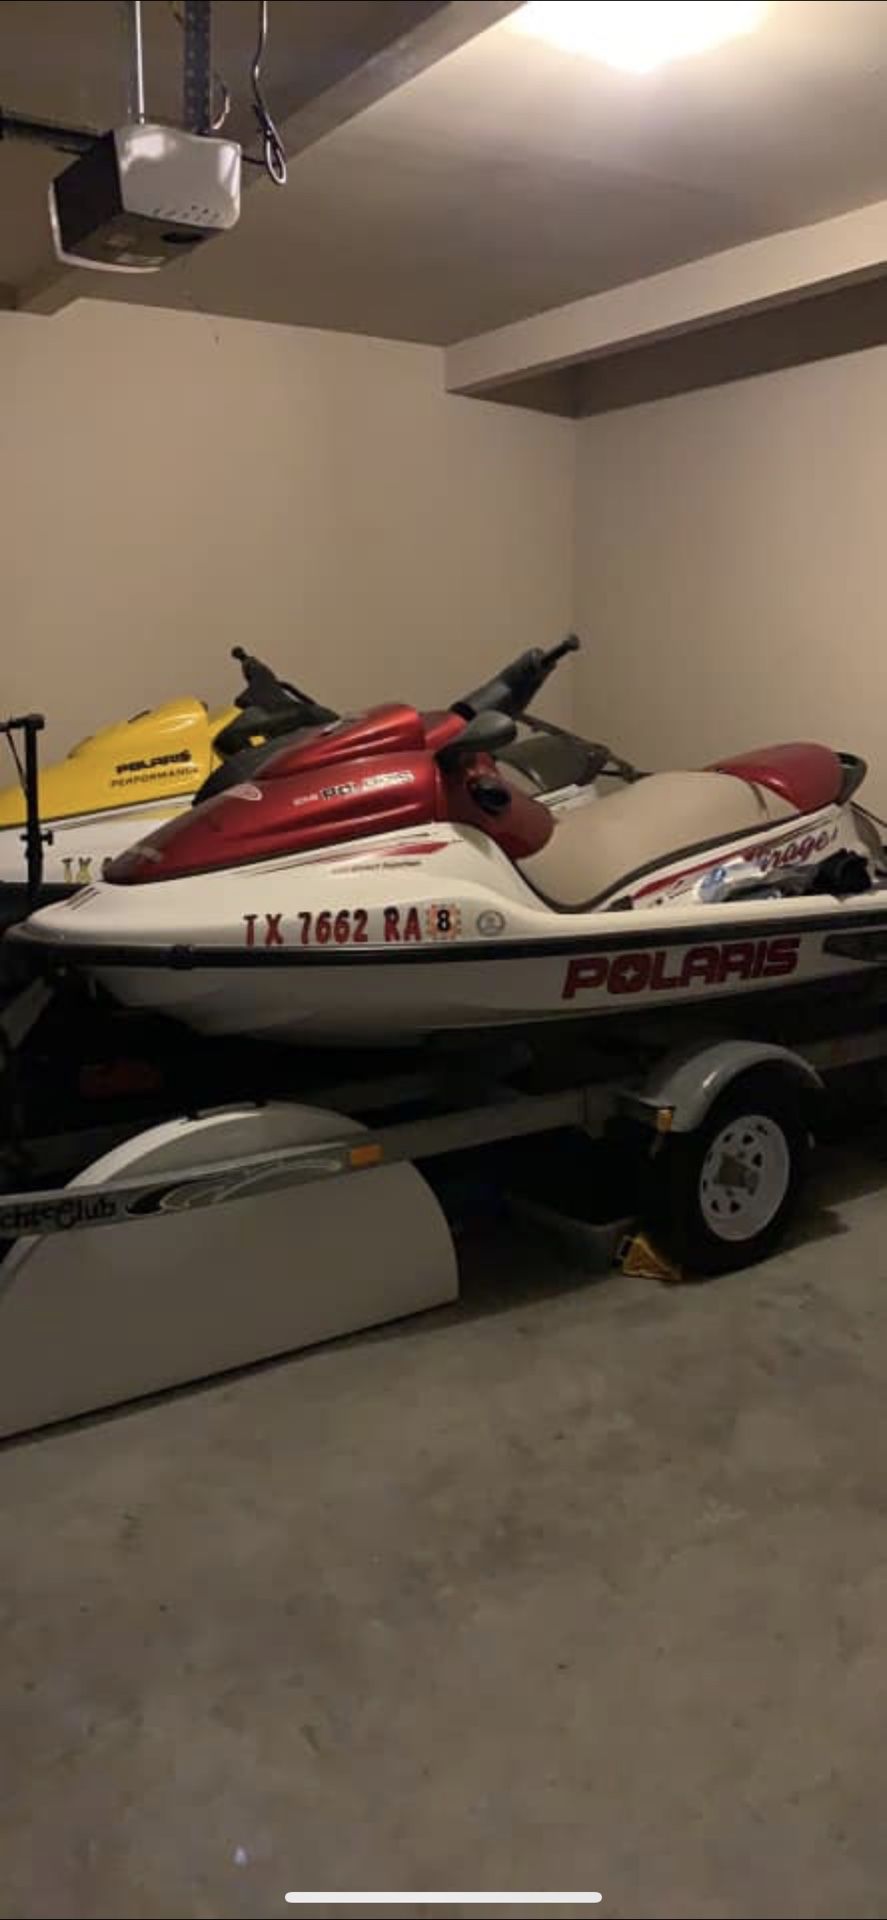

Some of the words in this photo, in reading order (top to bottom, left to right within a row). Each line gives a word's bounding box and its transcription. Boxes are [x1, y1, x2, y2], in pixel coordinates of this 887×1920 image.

[116, 749, 191, 775] POLARIS
[243, 913, 285, 946] TX
[298, 907, 369, 945] 7662
[383, 906, 422, 942] RA
[436, 909, 451, 932] 8
[562, 938, 802, 1000] POLARIS
